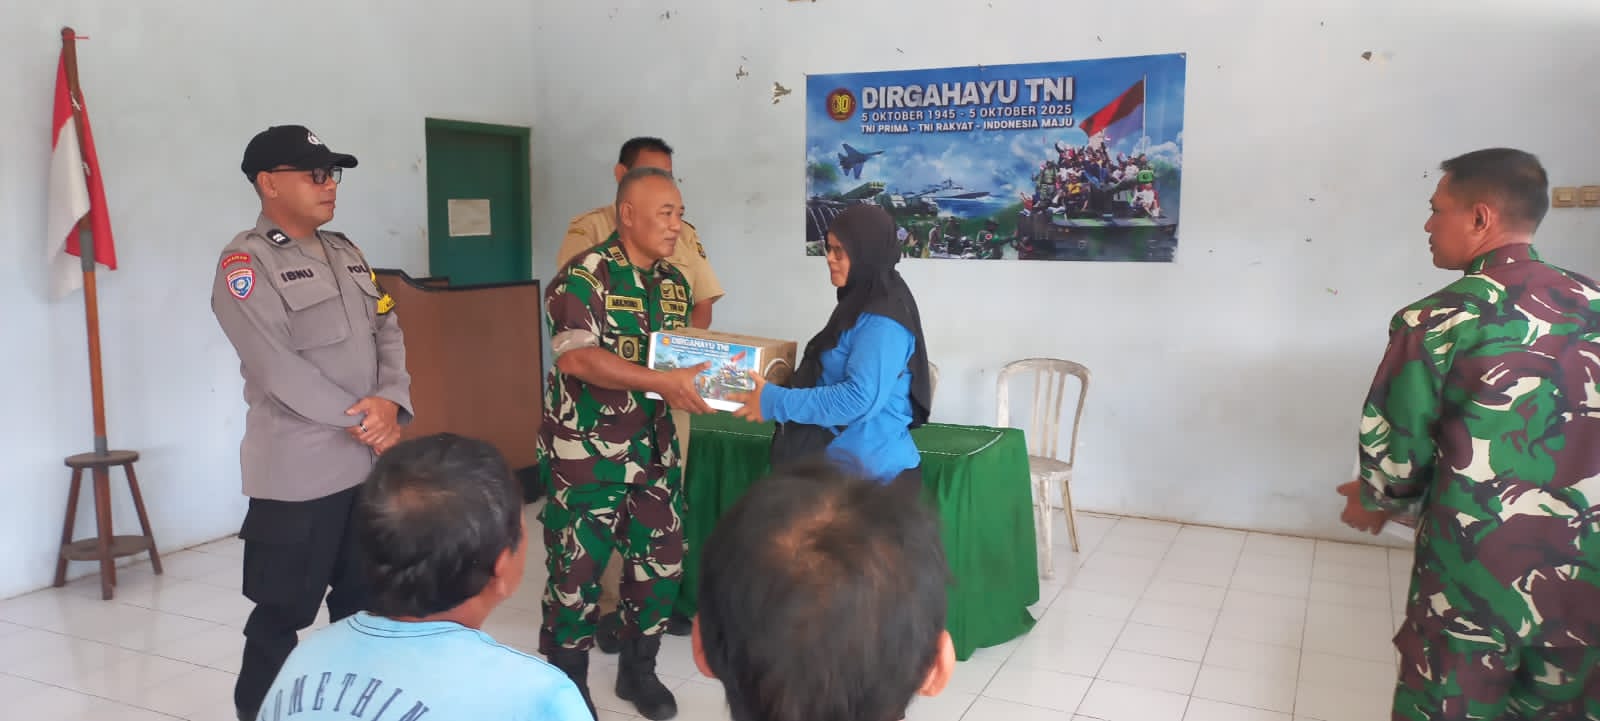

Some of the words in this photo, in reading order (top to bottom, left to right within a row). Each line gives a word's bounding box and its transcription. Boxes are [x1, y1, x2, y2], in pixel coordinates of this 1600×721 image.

[861, 79, 1017, 110] DIRGAHAYU
[1024, 76, 1074, 103] TNI
[862, 112, 868, 121] 5
[872, 110, 923, 121] OKTOBER
[928, 108, 955, 120] 1945
[969, 108, 977, 118] 5
[980, 105, 1036, 117] OKTOBER
[1041, 104, 1072, 115] 2025
[861, 124, 876, 134] TNI
[878, 124, 909, 133] PRIMA
[919, 123, 934, 133] TNI
[936, 121, 974, 132] RAKYAT
[983, 119, 1038, 130] INDONESIA
[1041, 117, 1073, 128] MAJU
[281, 268, 314, 282] IBNU
